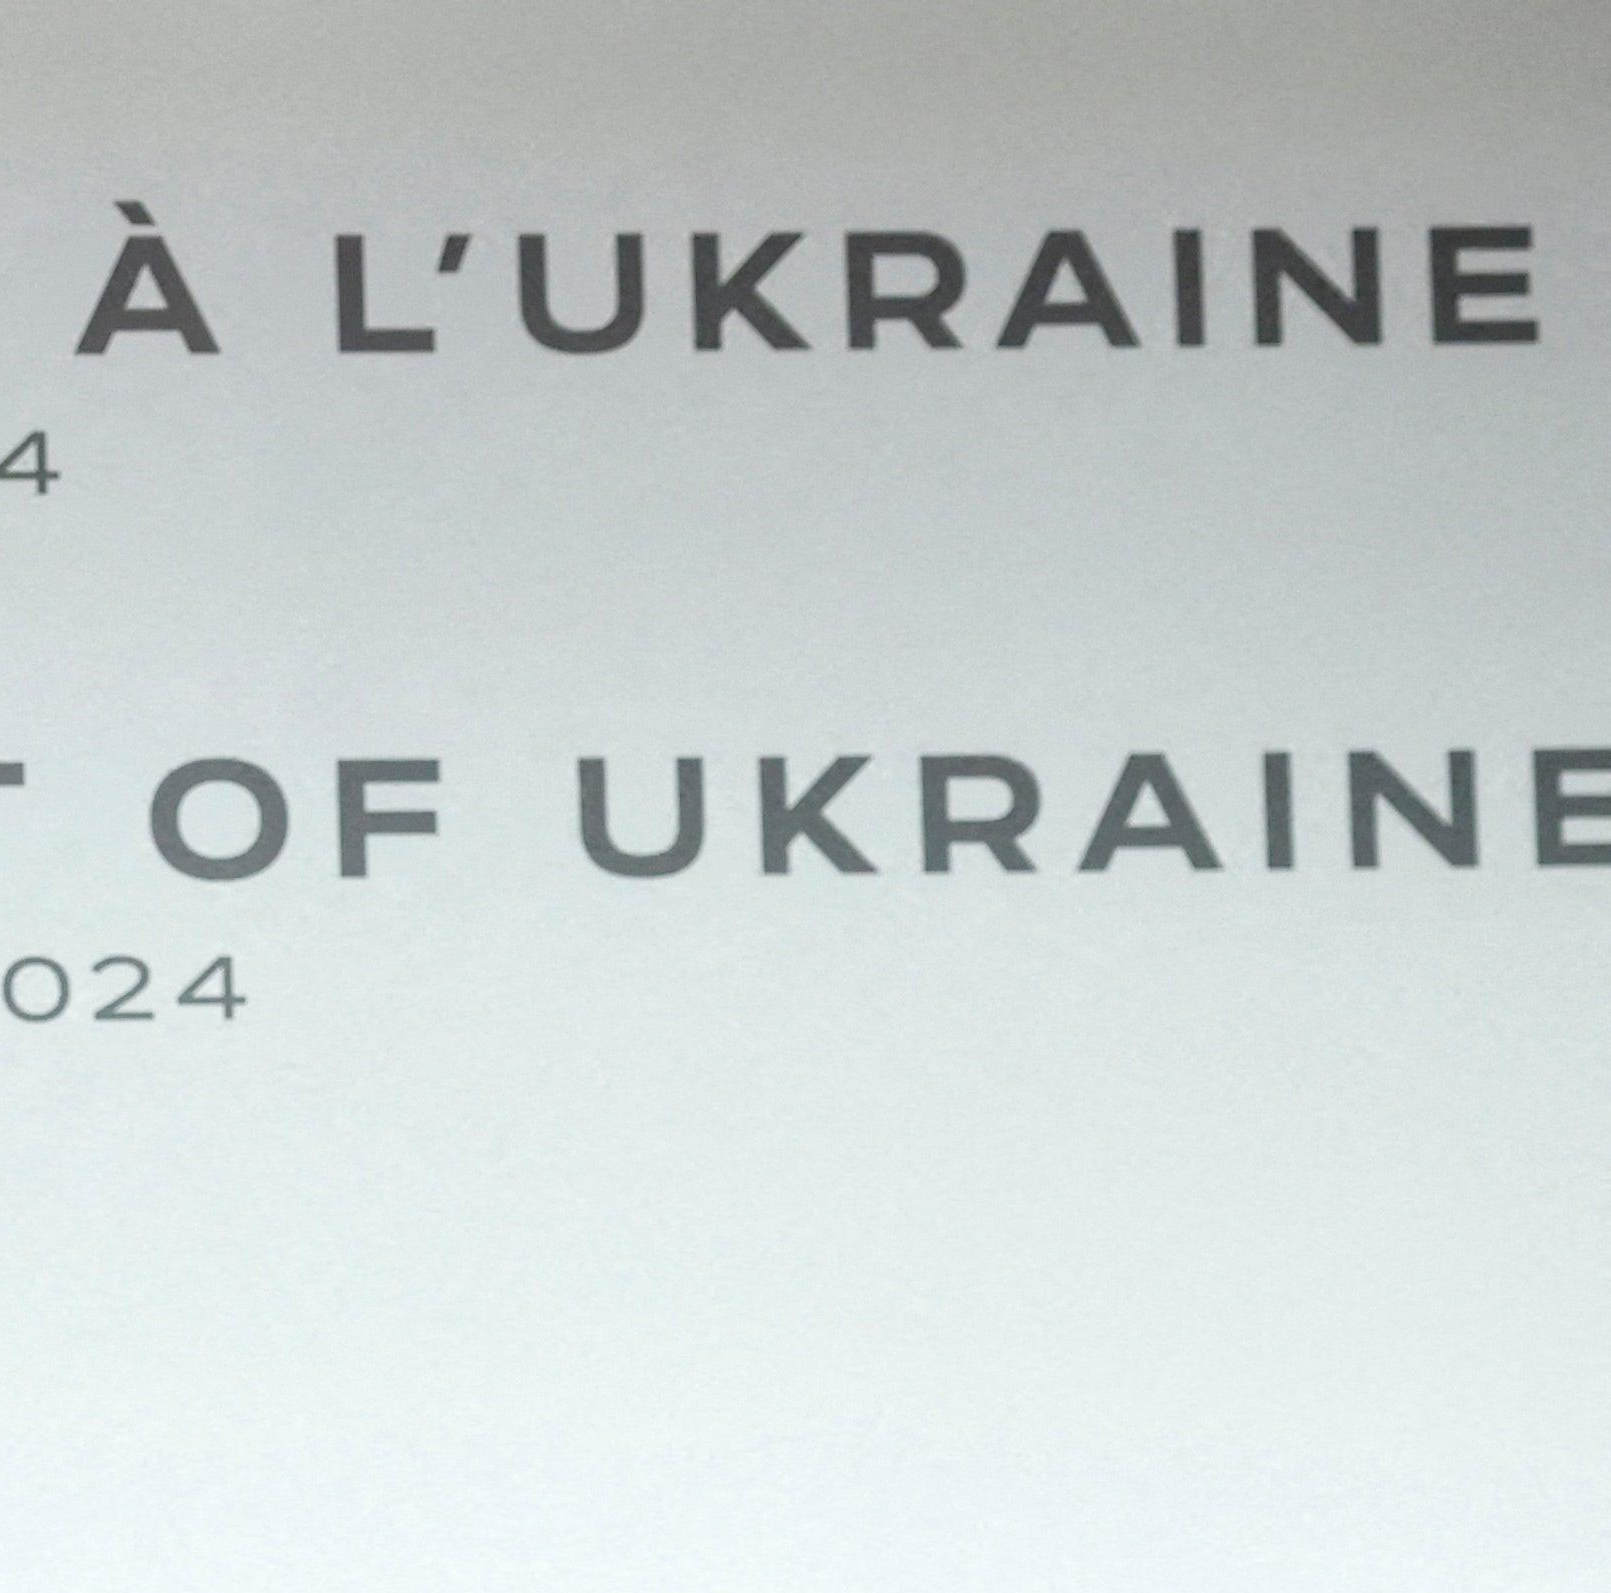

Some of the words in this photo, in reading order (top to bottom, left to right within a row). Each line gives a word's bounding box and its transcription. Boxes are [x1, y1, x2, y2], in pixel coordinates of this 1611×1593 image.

[76, 201, 219, 355] À
[335, 224, 1540, 355] L’UKRAINE
[151, 758, 440, 881] OF
[578, 747, 1611, 878] UKRAINE
